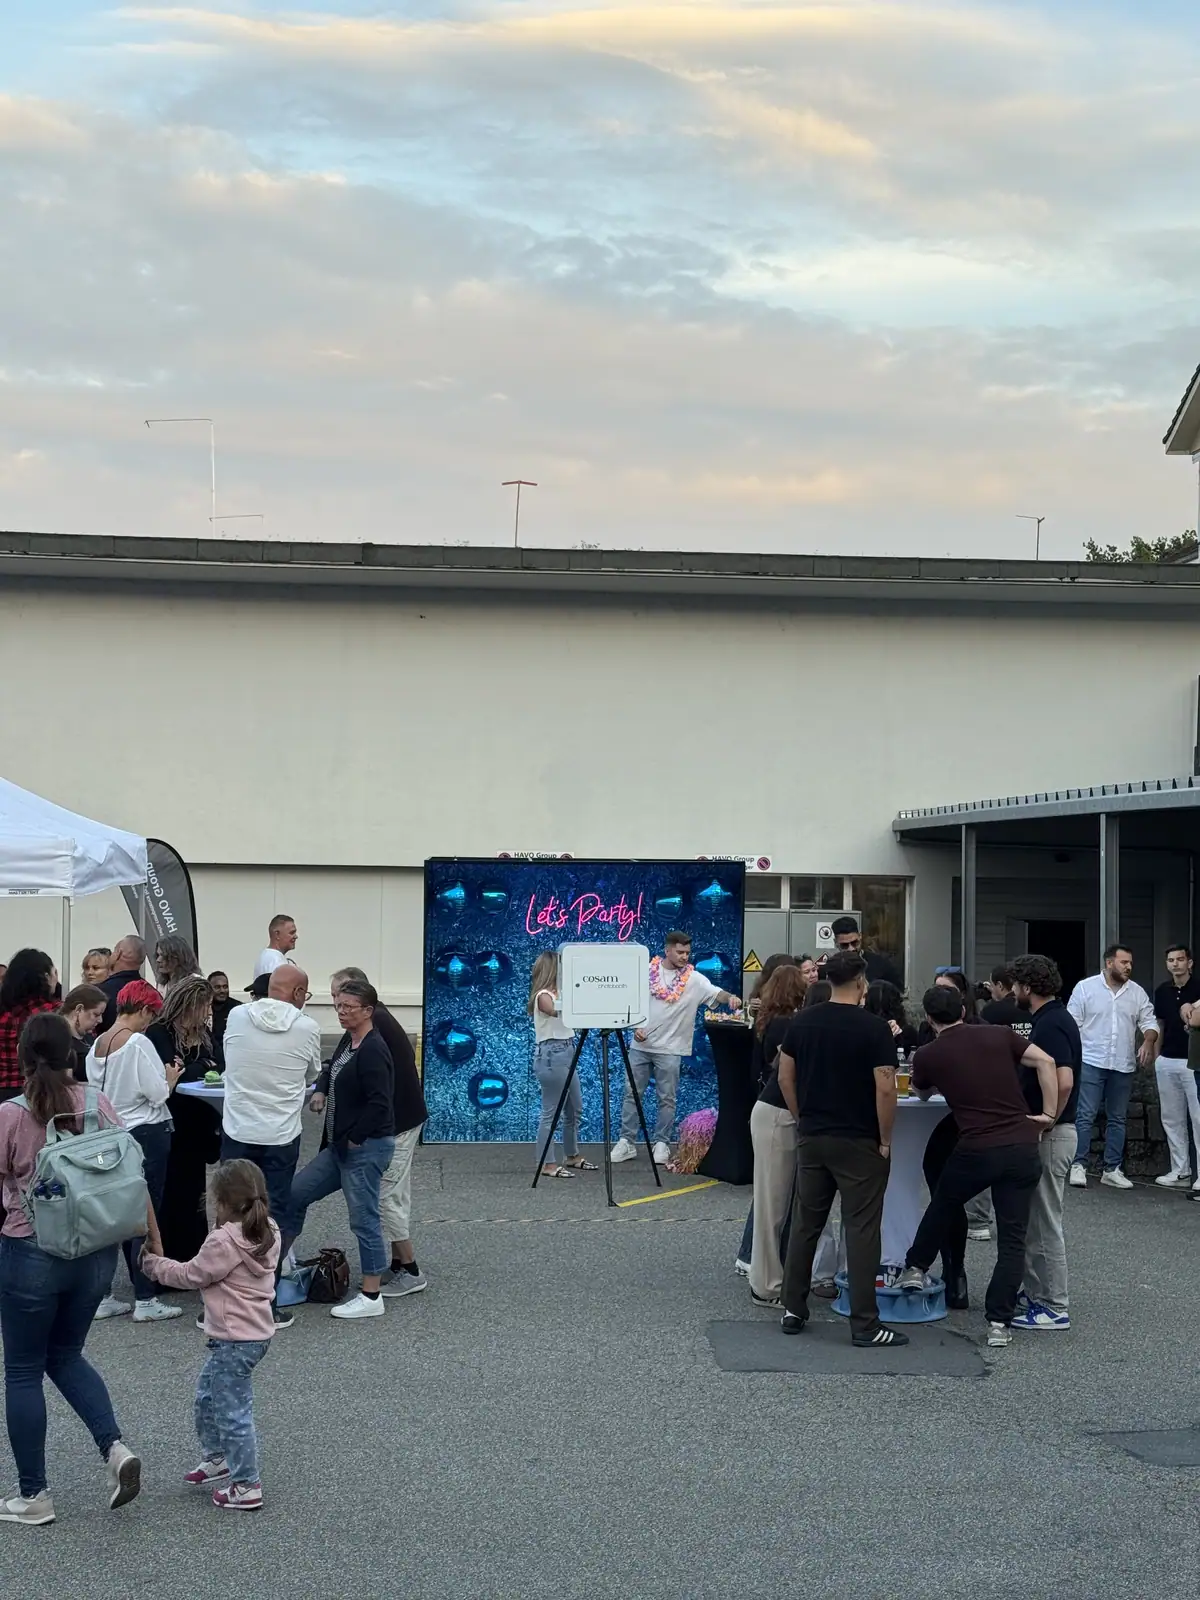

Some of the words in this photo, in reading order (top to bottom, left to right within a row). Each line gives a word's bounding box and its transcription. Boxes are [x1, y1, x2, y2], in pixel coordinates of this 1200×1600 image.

[733, 855, 755, 863] Group
[526, 893, 569, 935] Let's
[570, 891, 643, 941] Party!
[582, 975, 619, 983] cosam
